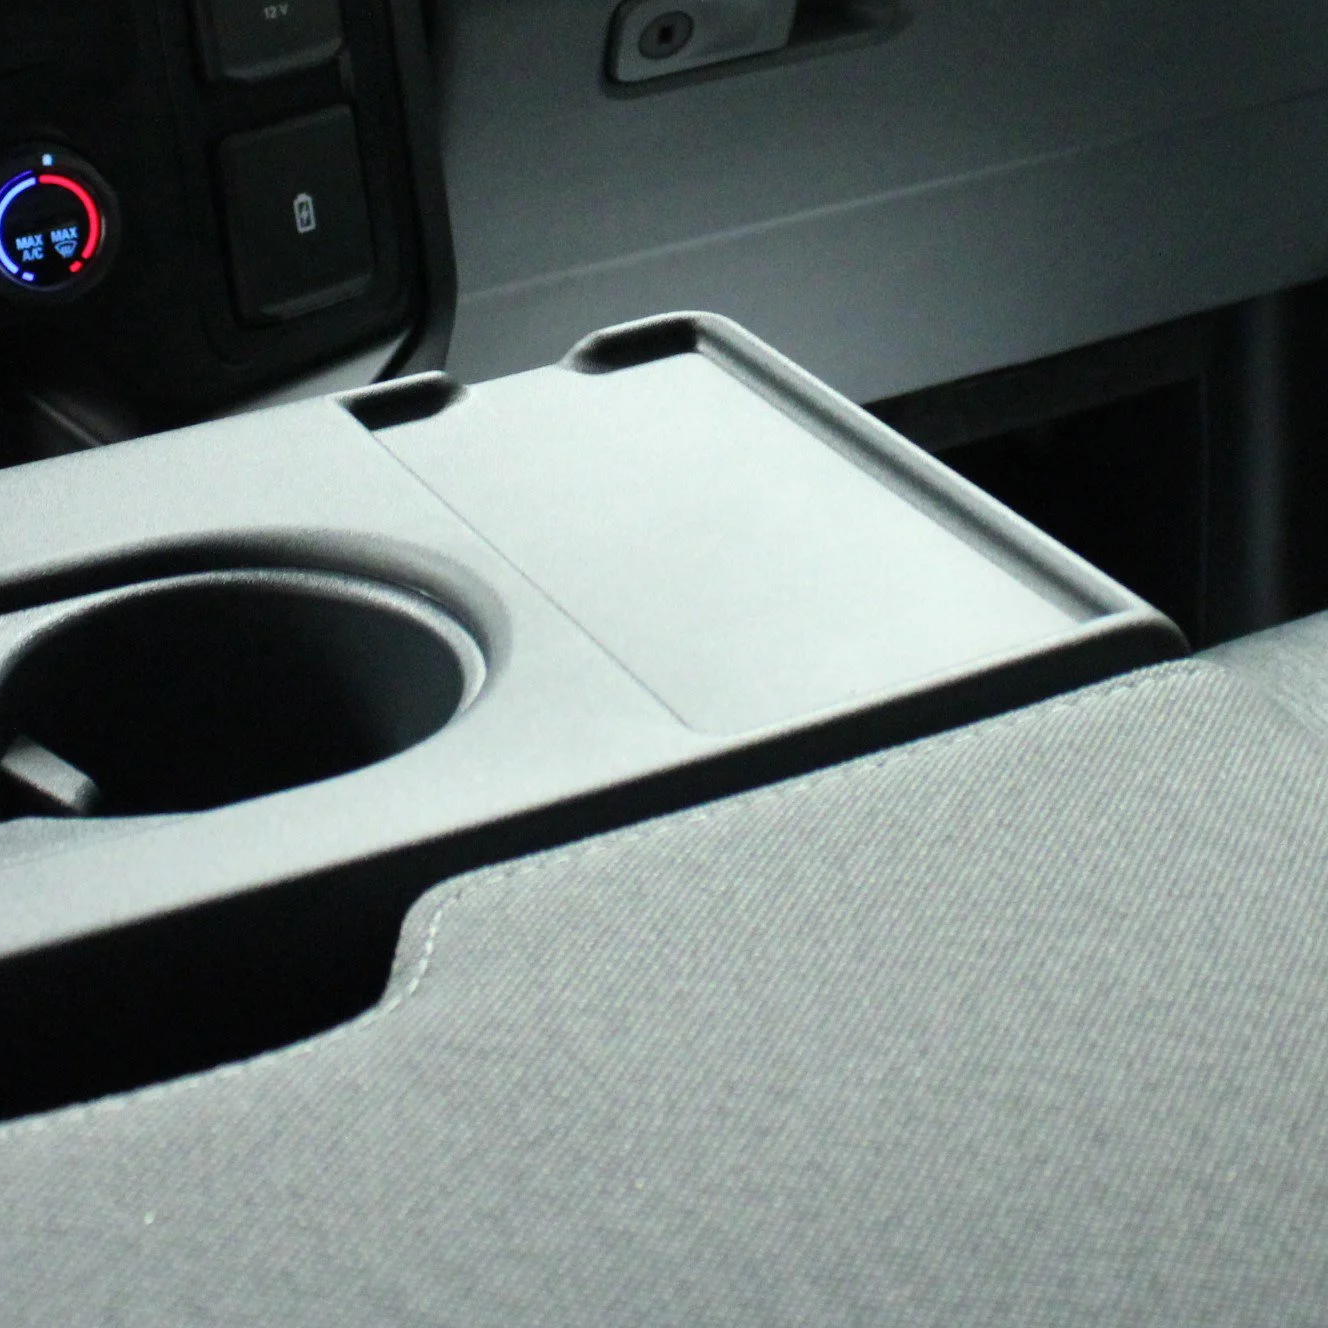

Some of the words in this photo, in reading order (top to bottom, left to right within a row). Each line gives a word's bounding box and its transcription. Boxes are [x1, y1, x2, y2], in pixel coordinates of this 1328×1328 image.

[15, 233, 45, 250] MAX
[50, 226, 79, 243] MAX
[22, 246, 45, 262] A/C
